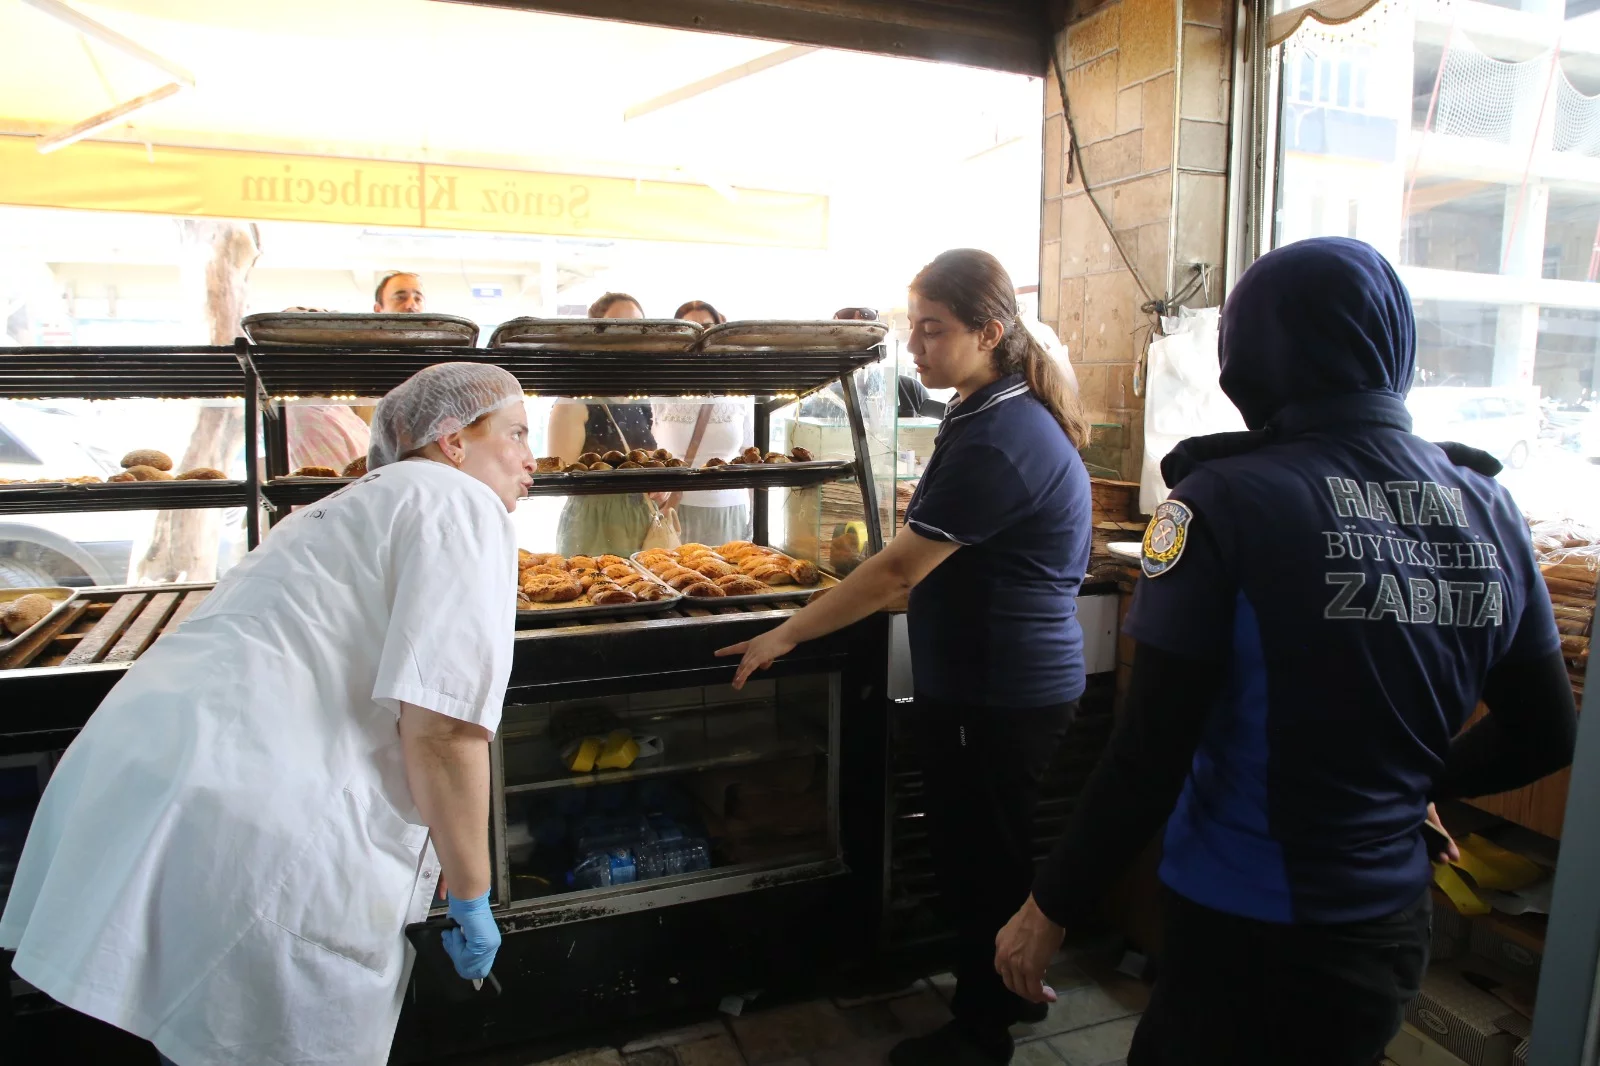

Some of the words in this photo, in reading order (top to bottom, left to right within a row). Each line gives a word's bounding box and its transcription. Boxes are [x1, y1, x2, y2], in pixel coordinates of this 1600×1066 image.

[1325, 476, 1469, 528] HATAY
[1322, 524, 1502, 574] BÜYÜKŞEHİR
[1324, 572, 1503, 627] ZABITA
